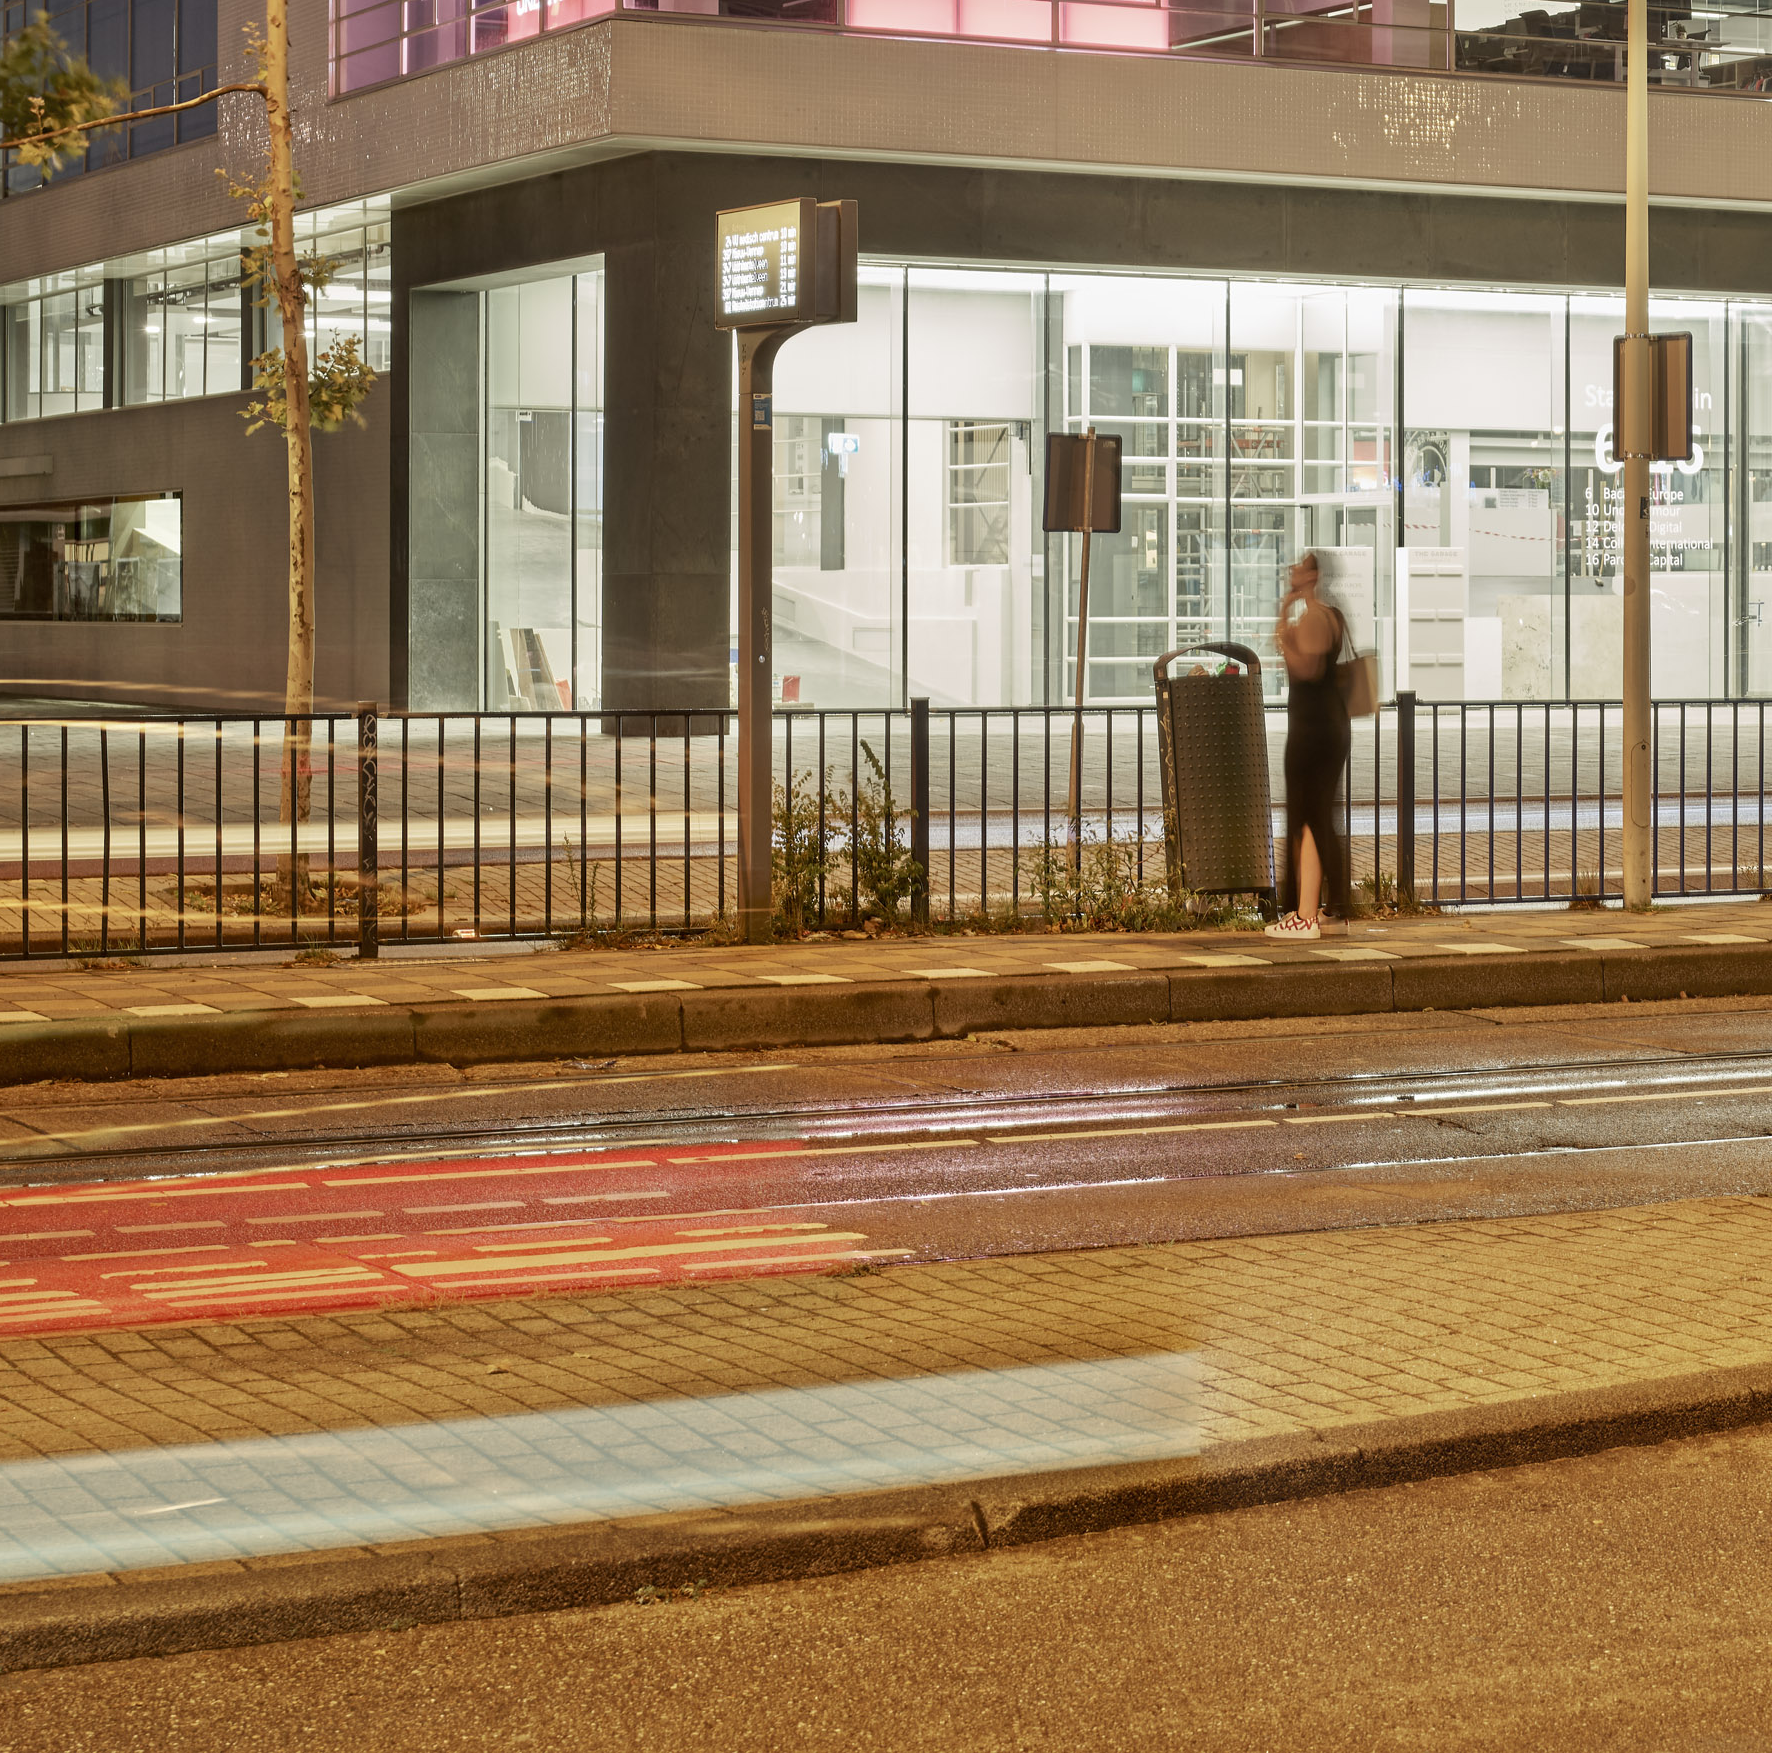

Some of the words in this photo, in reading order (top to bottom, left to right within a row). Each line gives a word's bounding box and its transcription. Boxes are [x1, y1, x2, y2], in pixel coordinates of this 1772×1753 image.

[1585, 487, 1592, 499] 6
[1585, 504, 1599, 516] 10
[1651, 507, 1681, 517] mour
[1585, 521, 1599, 533] 12
[1650, 521, 1683, 535] Digital
[1585, 537, 1599, 549] 14
[1603, 537, 1625, 549] Coll
[1650, 537, 1714, 550] nternational
[1585, 554, 1599, 566] 16
[1649, 553, 1684, 567] Capital
